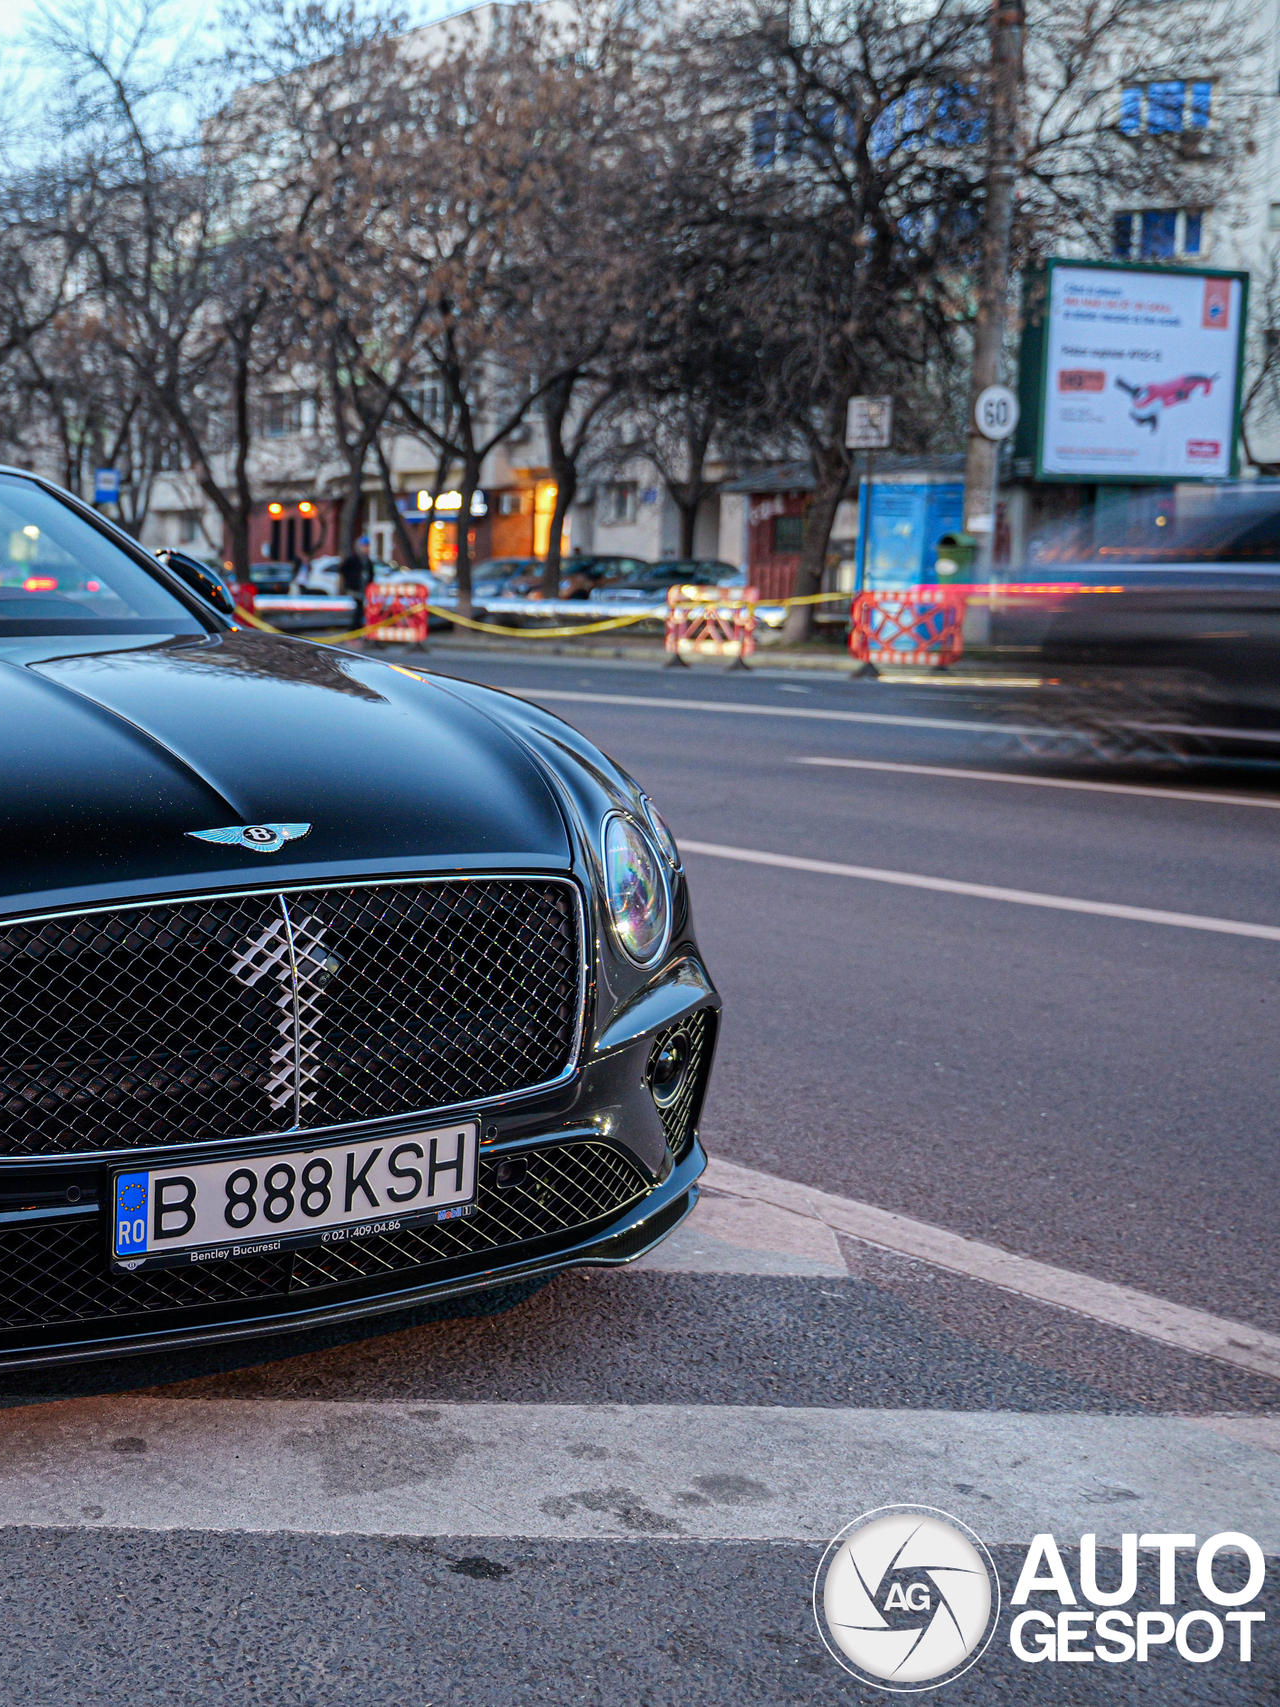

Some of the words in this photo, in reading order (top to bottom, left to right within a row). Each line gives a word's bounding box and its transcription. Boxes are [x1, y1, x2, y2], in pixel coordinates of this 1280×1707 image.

[983, 398, 1008, 428] 60
[248, 828, 271, 840] B
[153, 1175, 197, 1241] B
[223, 1157, 333, 1229] 888
[344, 1132, 466, 1213] KSH
[437, 1207, 462, 1221] Mobil
[119, 1218, 146, 1245] RO
[332, 1220, 401, 1241] 021.409.04.86
[190, 1246, 230, 1263] Bentley
[232, 1240, 281, 1257] Bucuresti
